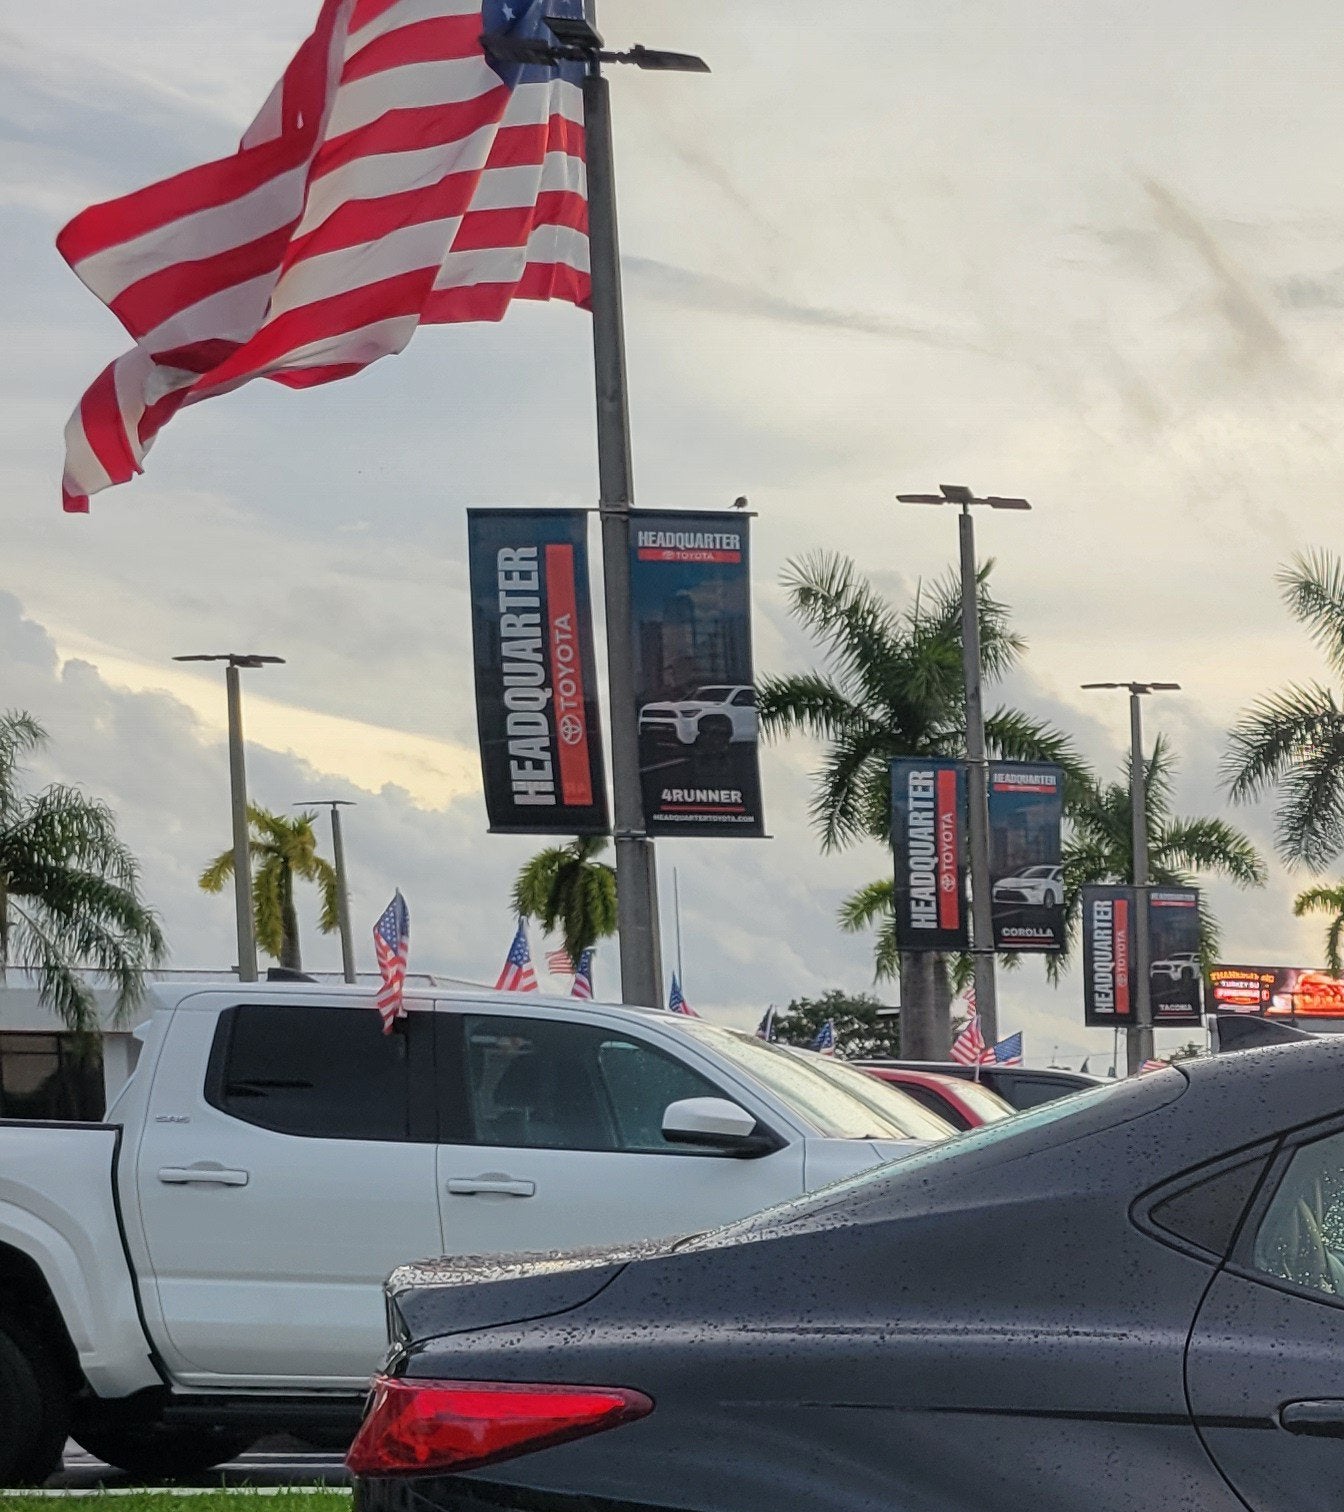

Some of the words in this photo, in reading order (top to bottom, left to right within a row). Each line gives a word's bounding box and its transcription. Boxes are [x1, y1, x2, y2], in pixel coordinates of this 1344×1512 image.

[638, 530, 741, 550] HEADQUARTER
[675, 551, 714, 560] TOYOTA
[498, 547, 557, 806] HEADQUARTER
[555, 613, 578, 710] TOYOTA
[661, 788, 742, 803] 4RUNNER
[993, 773, 1057, 786] HEADQUARTER
[909, 770, 938, 930] HEADQUARTER
[941, 813, 954, 869] TOYOTA
[1002, 927, 1054, 938] COROLLA
[1093, 900, 1115, 1014] HEADQUARTER
